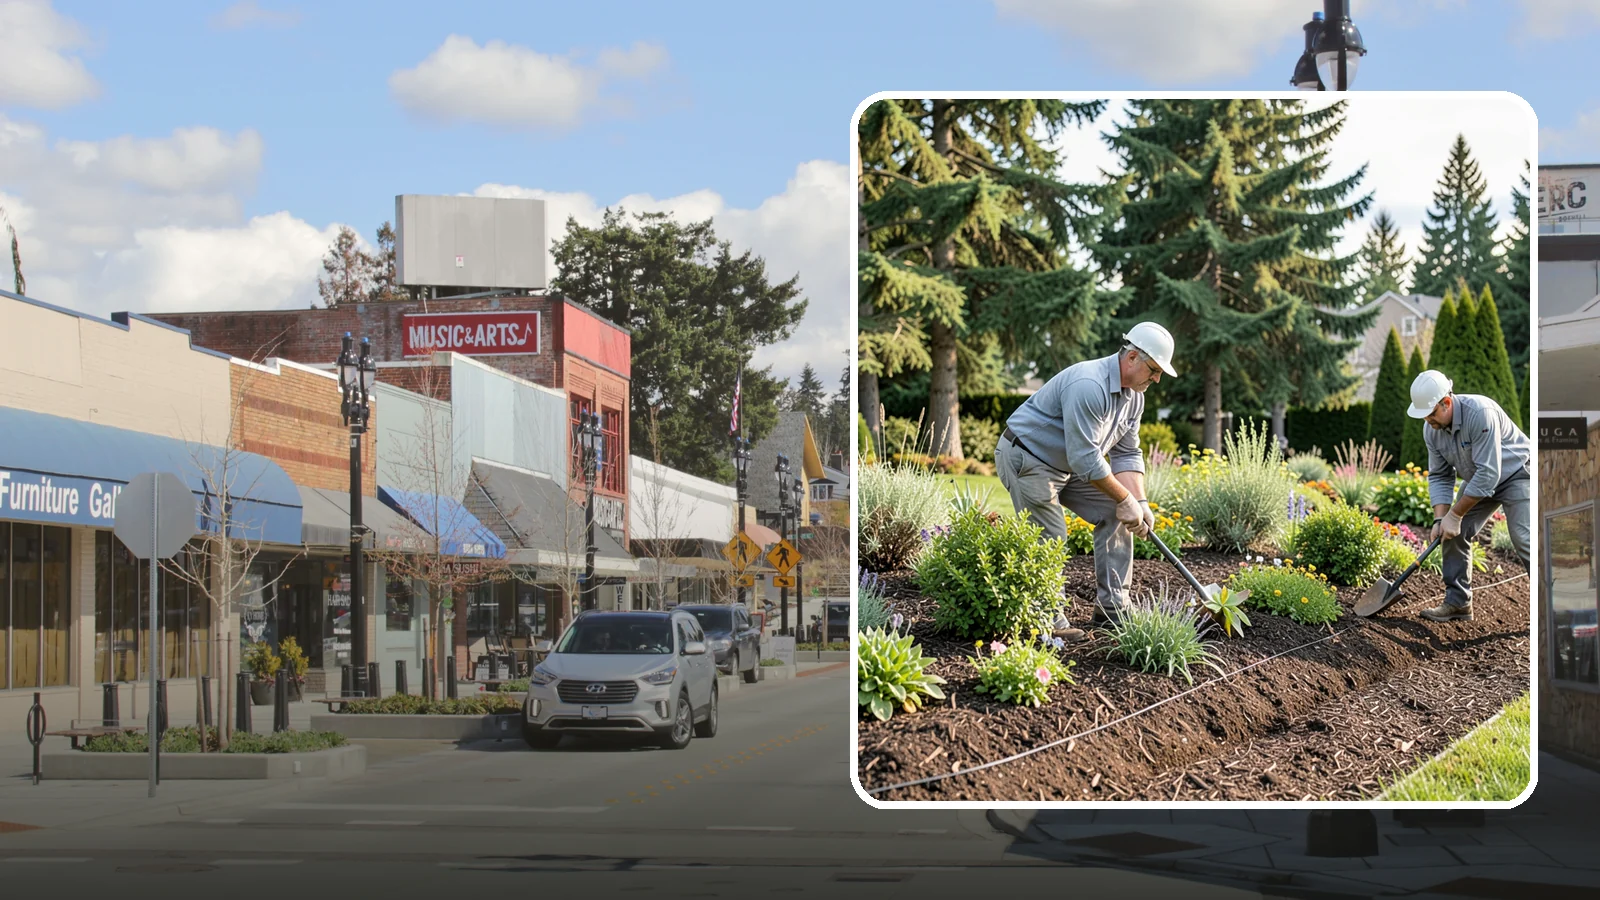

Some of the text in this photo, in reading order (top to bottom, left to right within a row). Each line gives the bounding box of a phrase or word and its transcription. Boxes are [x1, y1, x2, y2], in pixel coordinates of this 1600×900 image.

[409, 323, 520, 349] MUSIC&ARTS
[0, 471, 80, 516] Furniture
[453, 563, 480, 574] SUSHI
